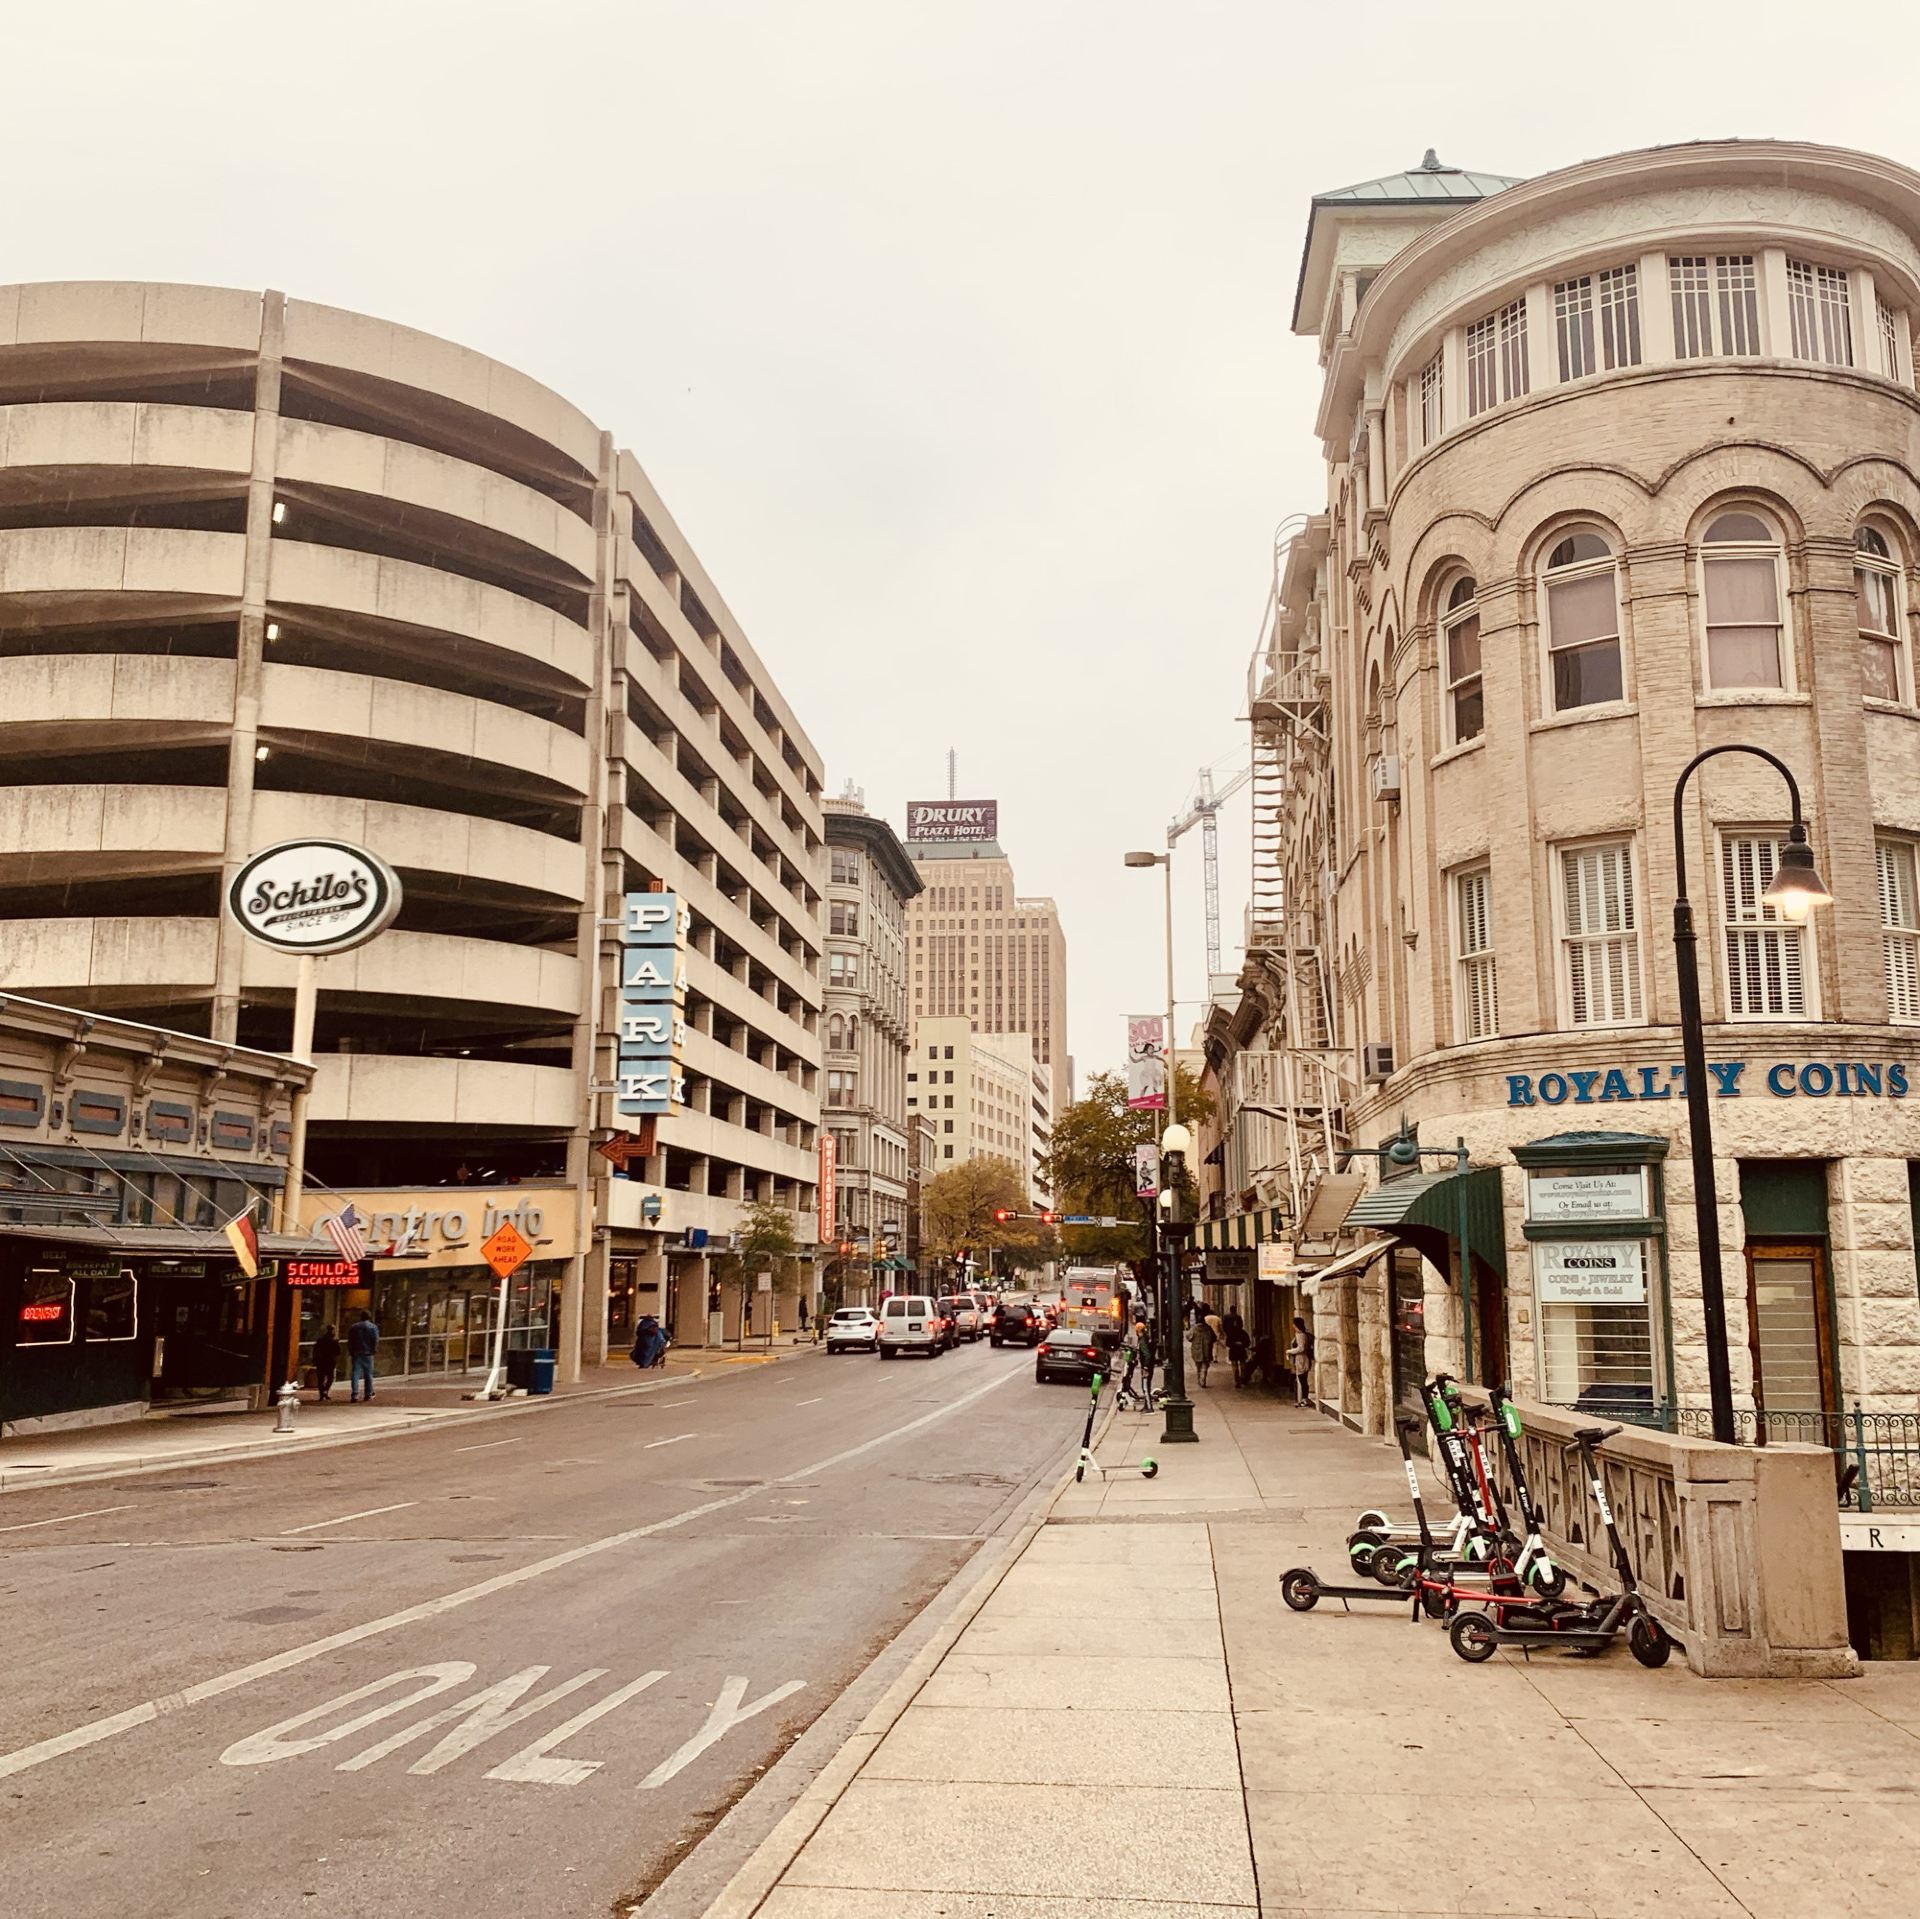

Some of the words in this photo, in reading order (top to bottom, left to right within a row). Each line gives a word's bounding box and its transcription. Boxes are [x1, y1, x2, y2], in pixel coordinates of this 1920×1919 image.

[913, 807, 987, 824] DRURY
[915, 826, 950, 836] PLAZA
[953, 826, 986, 836] HOTEL
[248, 870, 368, 915] Schilo's
[285, 915, 322, 932] SINCE
[620, 905, 671, 1100] PARK
[1767, 1063, 1909, 1097] COINS
[825, 1140, 833, 1238] WHATABURGER
[1553, 1182, 1573, 1190] Come
[1575, 1181, 1591, 1189] Visit
[1605, 1180, 1616, 1188] At:
[482, 1197, 544, 1237] info
[1541, 1244, 1638, 1269] ROYALTY
[1567, 1258, 1613, 1268] COINS
[287, 1262, 359, 1276] SCHILO'S
[1548, 1274, 1579, 1284] COINS
[1588, 1274, 1634, 1285] JEWELRY
[1560, 1286, 1591, 1296] Bought
[1603, 1286, 1623, 1295] Sold
[1480, 1451, 1491, 1474] BIRD
[1408, 1467, 1418, 1492] BIRD
[1598, 1487, 1612, 1517] BIRD
[1869, 1527, 1885, 1549] R
[219, 1660, 808, 1790] ONLY
